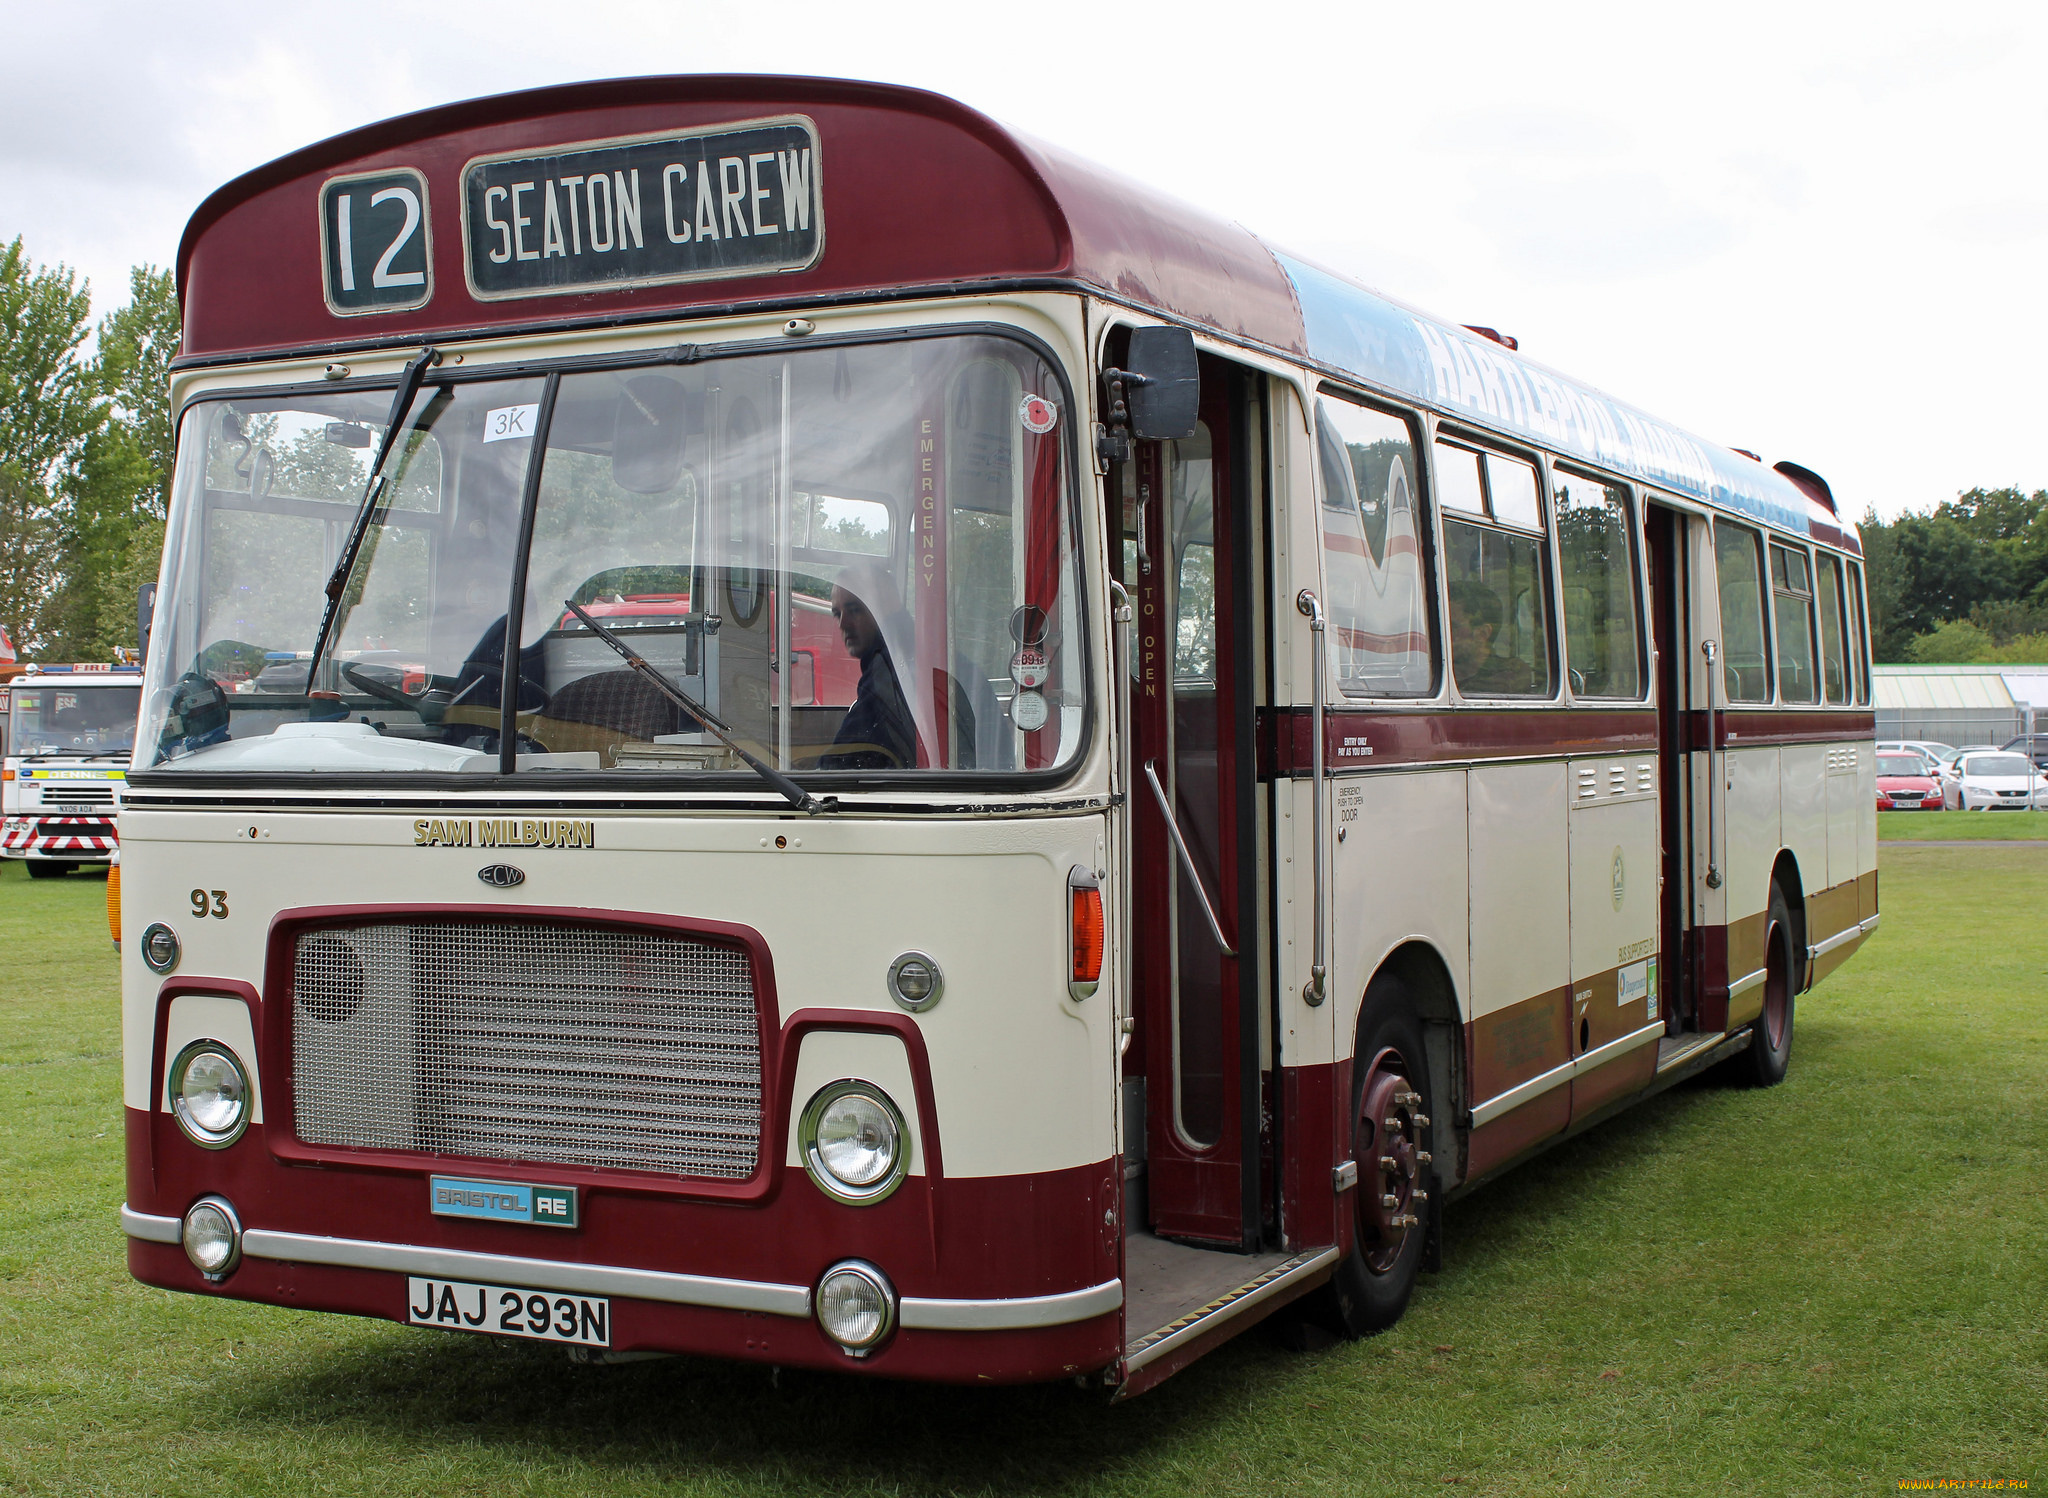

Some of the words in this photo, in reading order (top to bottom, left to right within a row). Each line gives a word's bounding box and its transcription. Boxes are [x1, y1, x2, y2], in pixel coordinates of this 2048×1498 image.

[483, 168, 644, 264] SEATON
[663, 147, 811, 245] CAREW
[337, 186, 425, 292] 12
[1411, 317, 1634, 468] HARTLEPOOL
[494, 407, 525, 435] 3K
[921, 419, 934, 587] EMERGENCY
[1144, 587, 1154, 616] TO
[1021, 654, 1034, 665] 09
[1144, 635, 1155, 697] OPEN
[1337, 747, 1346, 757] PAY
[1345, 747, 1352, 756] AS
[1352, 747, 1360, 756] YOU
[1360, 747, 1373, 756] ENTER
[1343, 737, 1357, 746] ENTRY
[1357, 737, 1367, 746] ONLY
[48, 770, 108, 779] DENNIS
[1339, 786, 1361, 797] EMERGENCY
[1347, 797, 1353, 806] TO
[1353, 796, 1364, 805] OPEN
[1341, 808, 1358, 822] DOOR
[413, 818, 472, 847] SAM
[477, 819, 596, 849] MILBURN
[479, 865, 523, 886] ECW
[189, 888, 230, 920] 93
[435, 1187, 528, 1213] BRISTOL
[411, 1282, 486, 1327] JAJ
[499, 1290, 606, 1343] 293N
